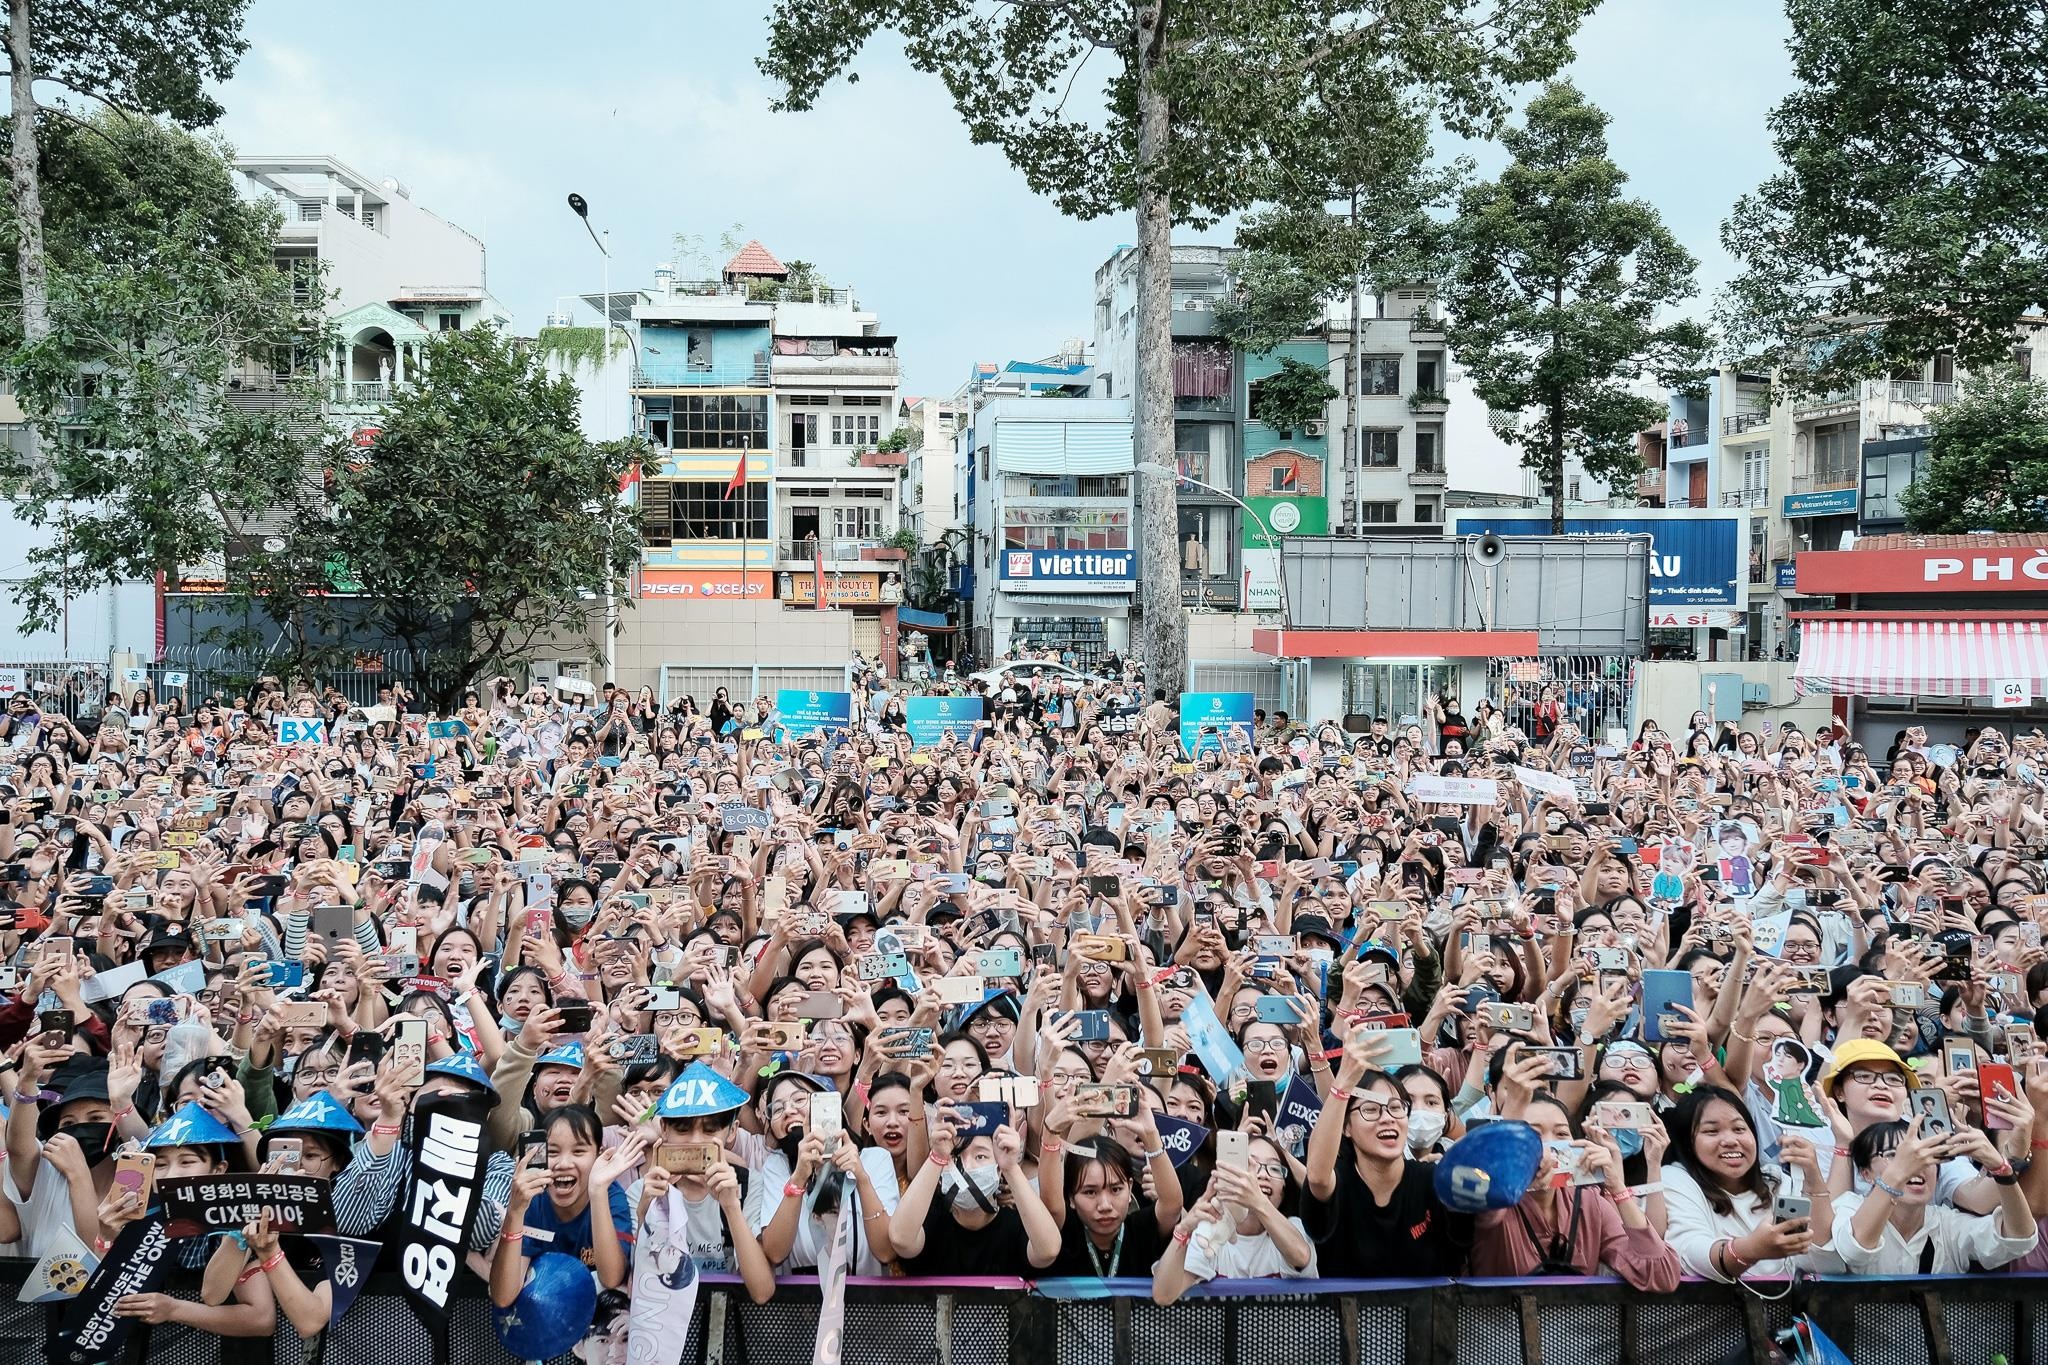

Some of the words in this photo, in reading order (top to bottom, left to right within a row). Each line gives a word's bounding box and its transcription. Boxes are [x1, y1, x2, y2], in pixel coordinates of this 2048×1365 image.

[2004, 684, 2022, 694] GA
[281, 721, 323, 743] BX
[737, 814, 760, 824] CIX
[666, 1078, 719, 1110] CIX
[177, 1185, 195, 1203] 내
[200, 1183, 251, 1202] 영화의
[256, 1183, 319, 1203] 주인공은
[53, 1253, 78, 1263] VIETNAM
[123, 1264, 154, 1295] THE
[148, 1229, 172, 1262] ON
[702, 1261, 726, 1270] APPLE
[76, 1311, 102, 1346] BABY
[99, 1272, 132, 1313] CAUSE
[130, 1221, 163, 1268] KNOW
